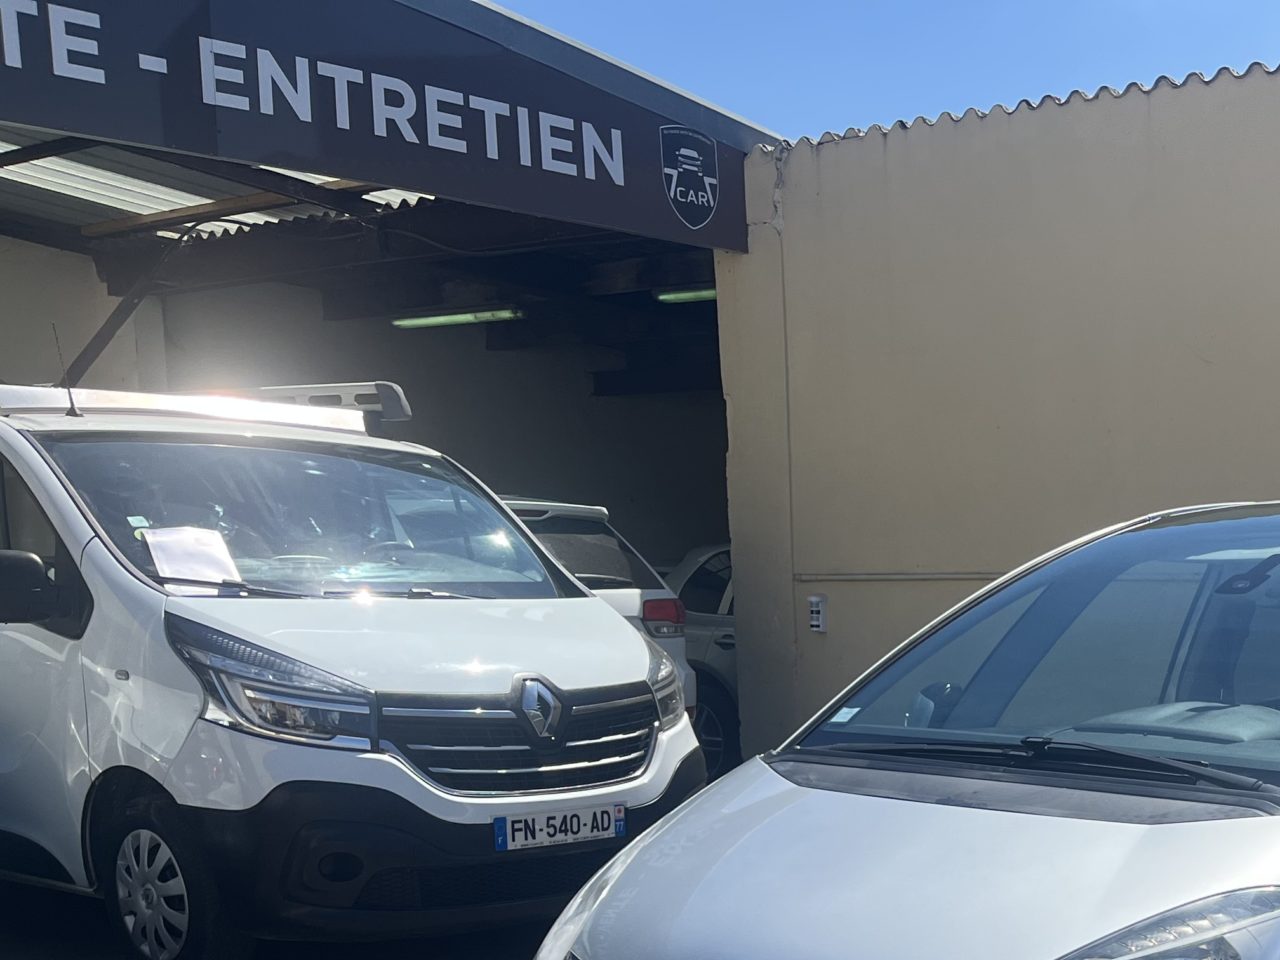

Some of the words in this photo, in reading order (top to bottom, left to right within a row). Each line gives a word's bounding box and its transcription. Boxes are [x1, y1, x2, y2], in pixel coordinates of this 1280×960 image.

[199, 36, 625, 187] ENTRETIEN
[510, 810, 612, 842] FN-540-AD
[615, 821, 624, 832] 77
